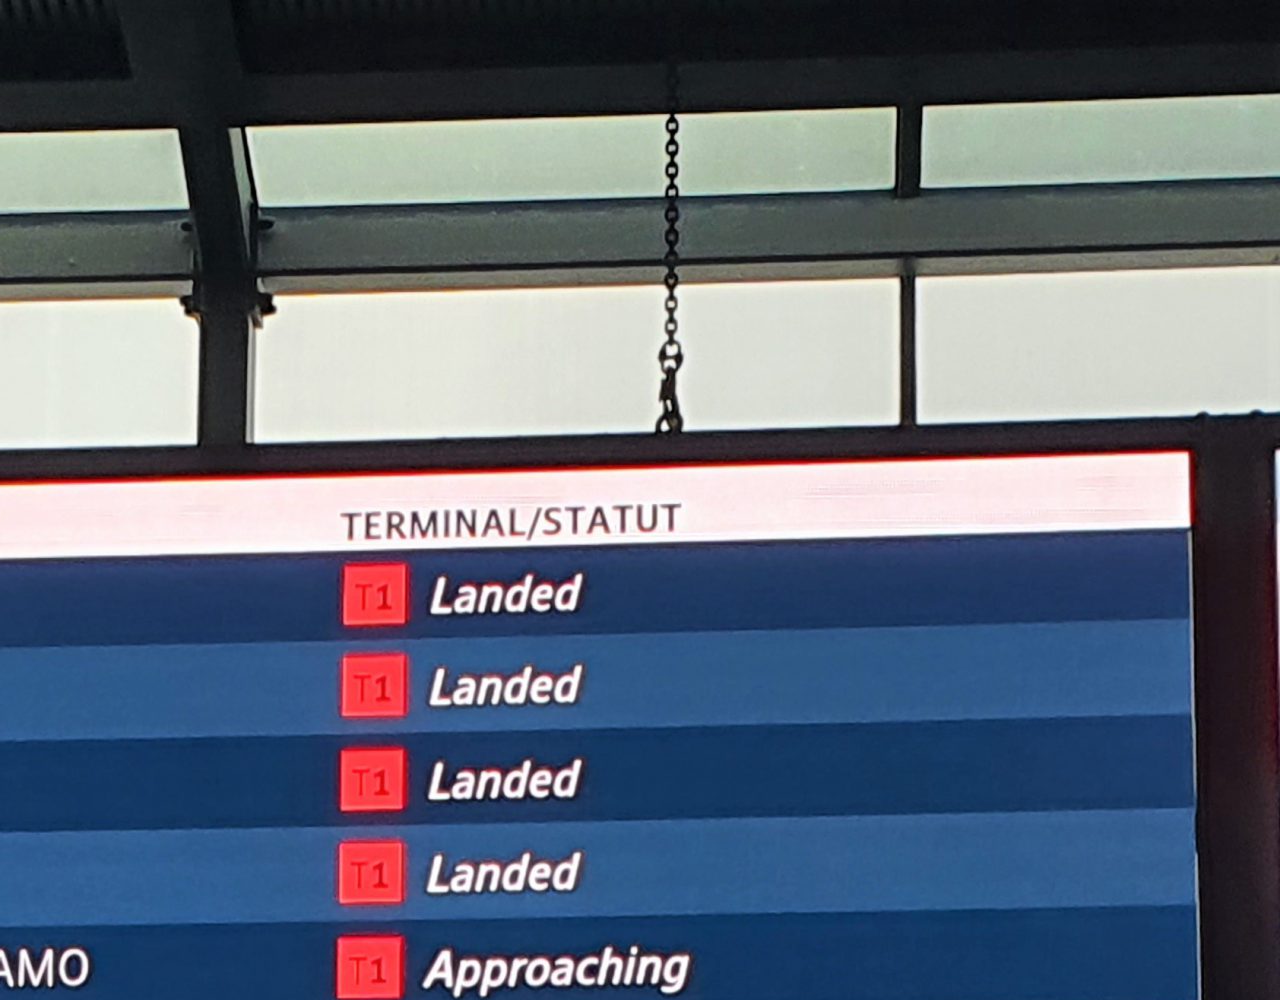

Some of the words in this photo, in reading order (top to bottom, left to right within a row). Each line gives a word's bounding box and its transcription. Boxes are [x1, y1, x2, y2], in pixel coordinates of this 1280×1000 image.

[340, 503, 683, 541] TERMINAL/STATUT
[354, 583, 393, 611] T1
[430, 573, 583, 615] Landed
[353, 674, 391, 702] T1
[429, 665, 583, 707] Landed
[351, 768, 390, 796] T1
[427, 759, 583, 801] Landed
[350, 860, 389, 889] T1
[426, 852, 582, 894] Landed
[348, 955, 387, 985] T1
[422, 945, 690, 998] Approaching
